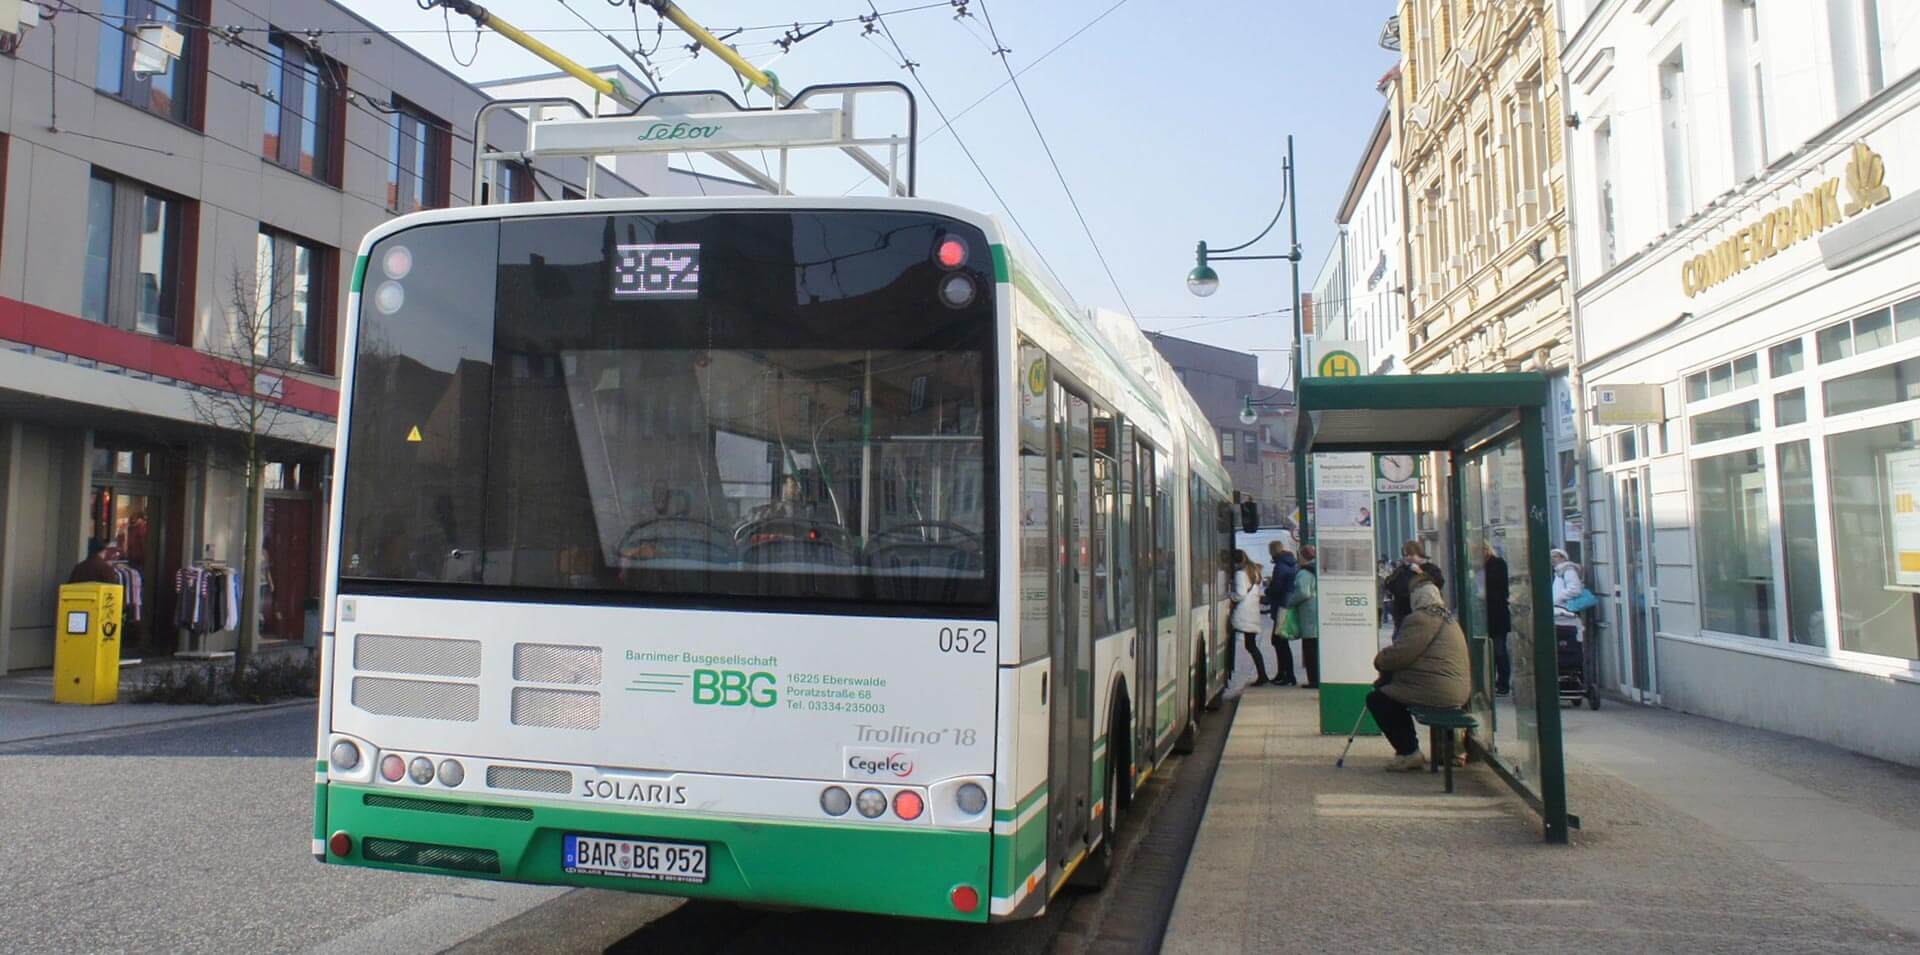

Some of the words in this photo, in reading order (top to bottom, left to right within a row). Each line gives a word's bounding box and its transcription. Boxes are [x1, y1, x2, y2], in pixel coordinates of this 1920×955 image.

[638, 122, 722, 140] Lekov
[1682, 176, 1843, 299] COMMERZBANK
[1345, 597, 1368, 606] BBG
[939, 627, 986, 653] 052
[625, 650, 679, 662] Barnimer
[682, 652, 778, 666] Busgesellschaft
[692, 668, 778, 708] BBG
[787, 673, 819, 684] 16225
[823, 675, 886, 687] Eberswalde
[787, 686, 856, 699] Poratzstraße
[858, 690, 872, 699] 68
[787, 700, 805, 710] Tel.
[808, 701, 885, 713] 03334-235003
[953, 728, 977, 746] 18
[849, 756, 908, 774] Cegelec
[583, 780, 687, 804] SOLARIS
[578, 841, 616, 867] BAR
[633, 845, 660, 870] BG
[666, 848, 704, 874] 952
